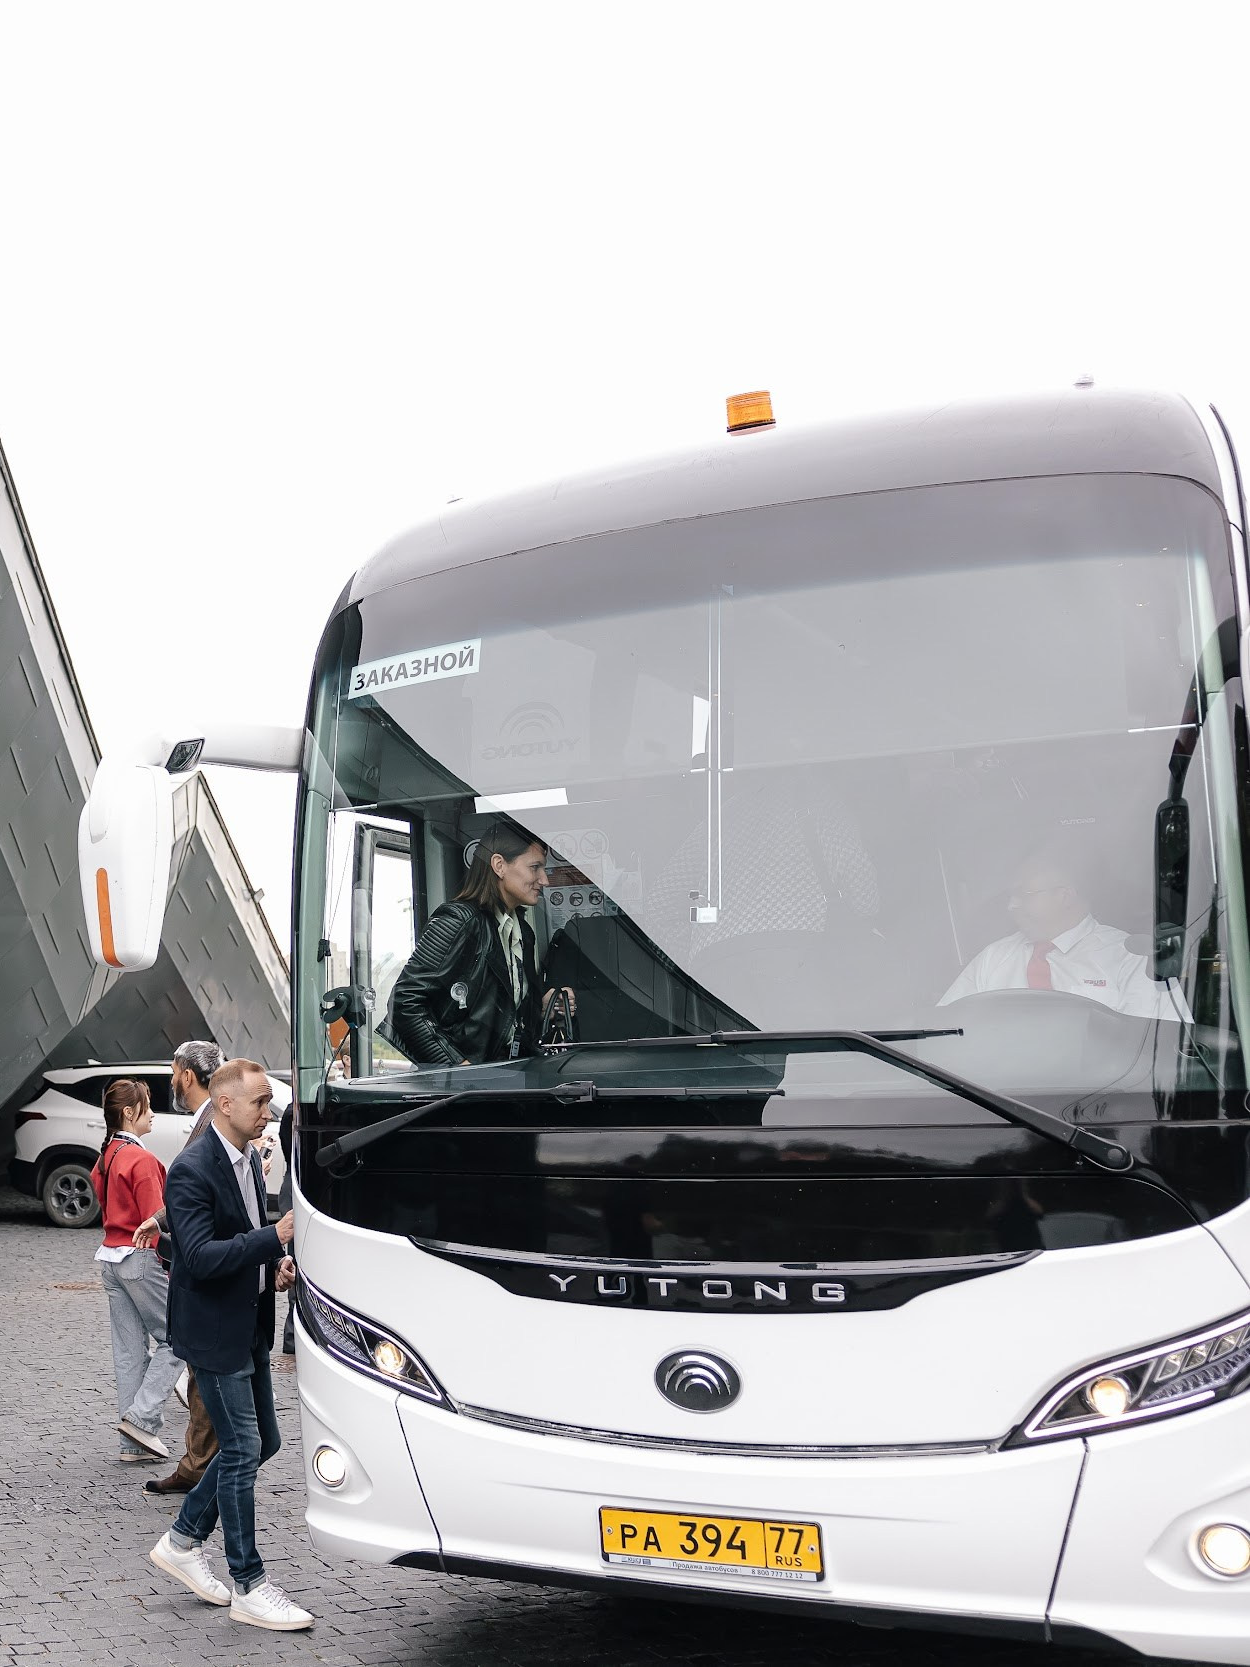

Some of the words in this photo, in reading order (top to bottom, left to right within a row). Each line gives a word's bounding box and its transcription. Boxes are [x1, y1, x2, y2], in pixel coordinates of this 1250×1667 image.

[353, 645, 476, 691] ЗАКАЗНОЙ
[549, 1273, 846, 1302] YUTONG
[678, 1521, 747, 1561] 394
[769, 1526, 805, 1555] 77
[672, 1561, 703, 1571] Продажа
[704, 1564, 739, 1574] автобусов
[775, 1555, 803, 1567] RUS
